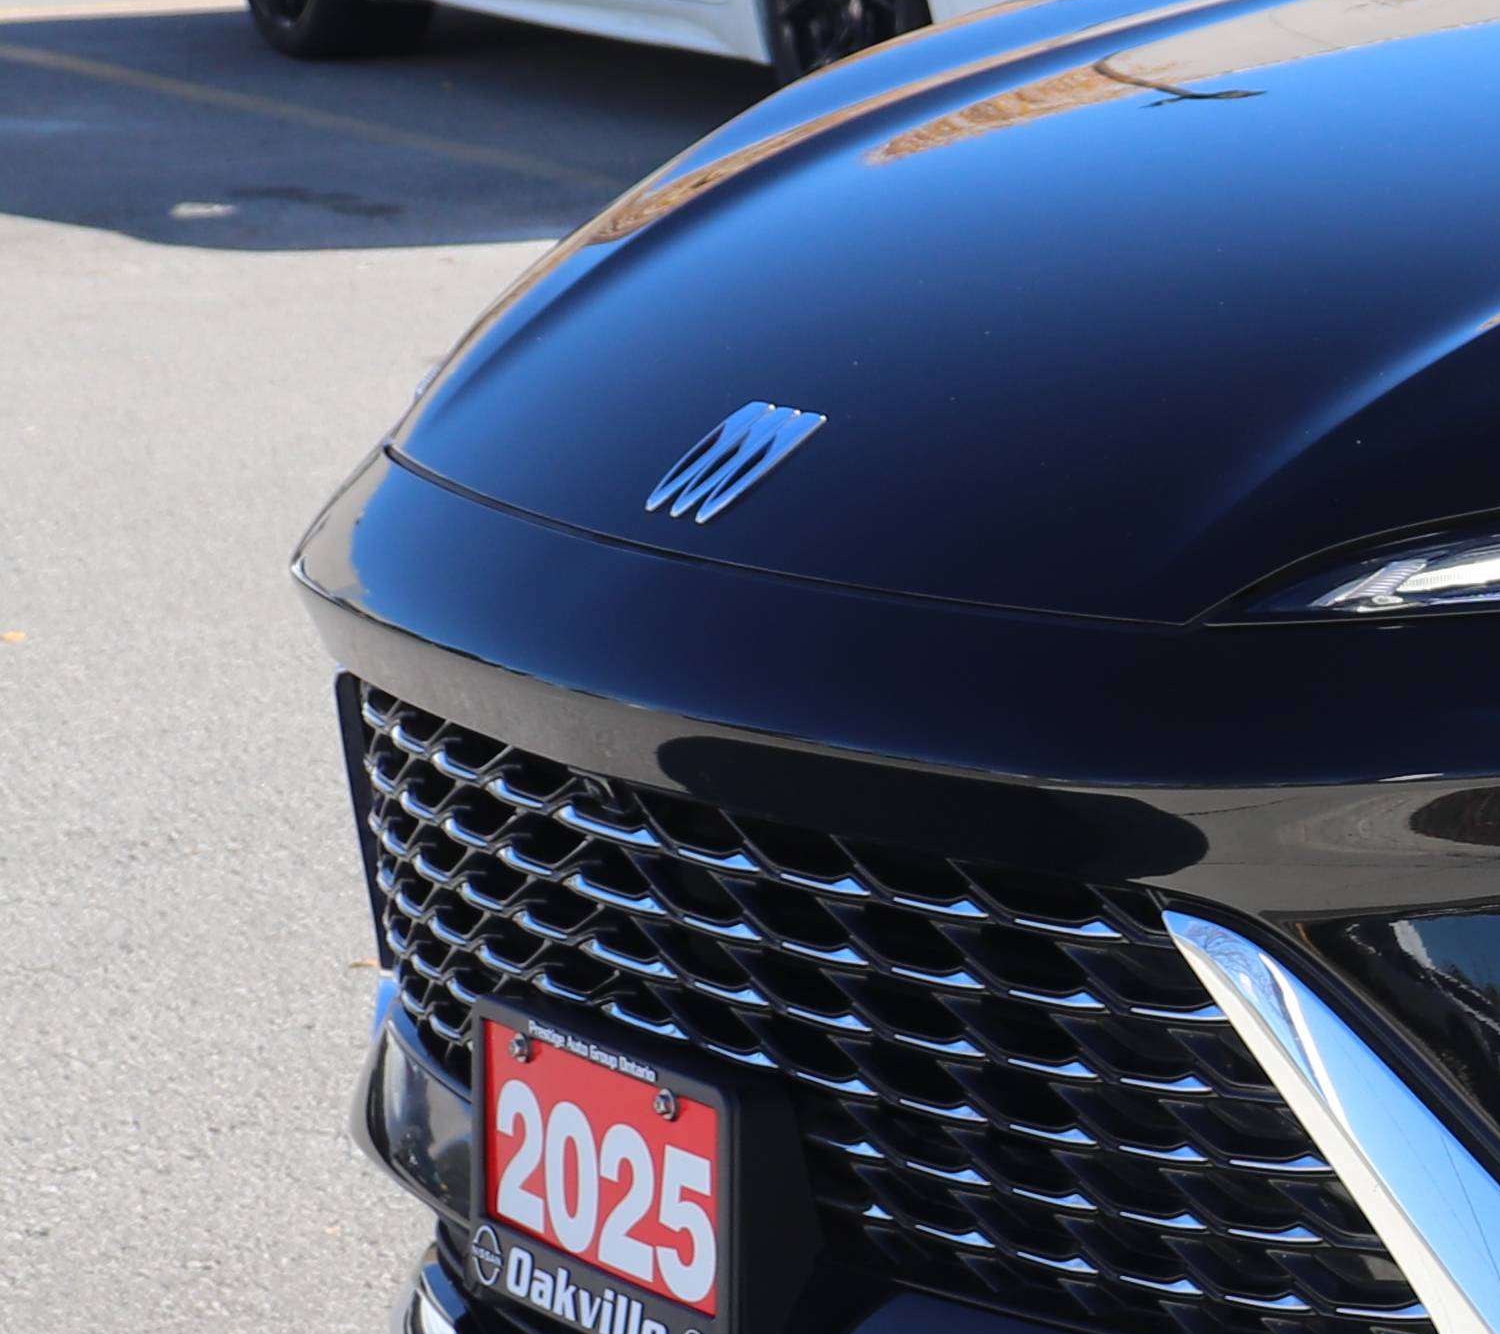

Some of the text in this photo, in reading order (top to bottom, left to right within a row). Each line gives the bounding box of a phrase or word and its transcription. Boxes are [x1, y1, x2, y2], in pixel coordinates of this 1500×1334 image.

[529, 1019, 657, 1083] Prestige Auto Group Ontario
[497, 1079, 717, 1303] 2025
[472, 1242, 502, 1266] NISSAN
